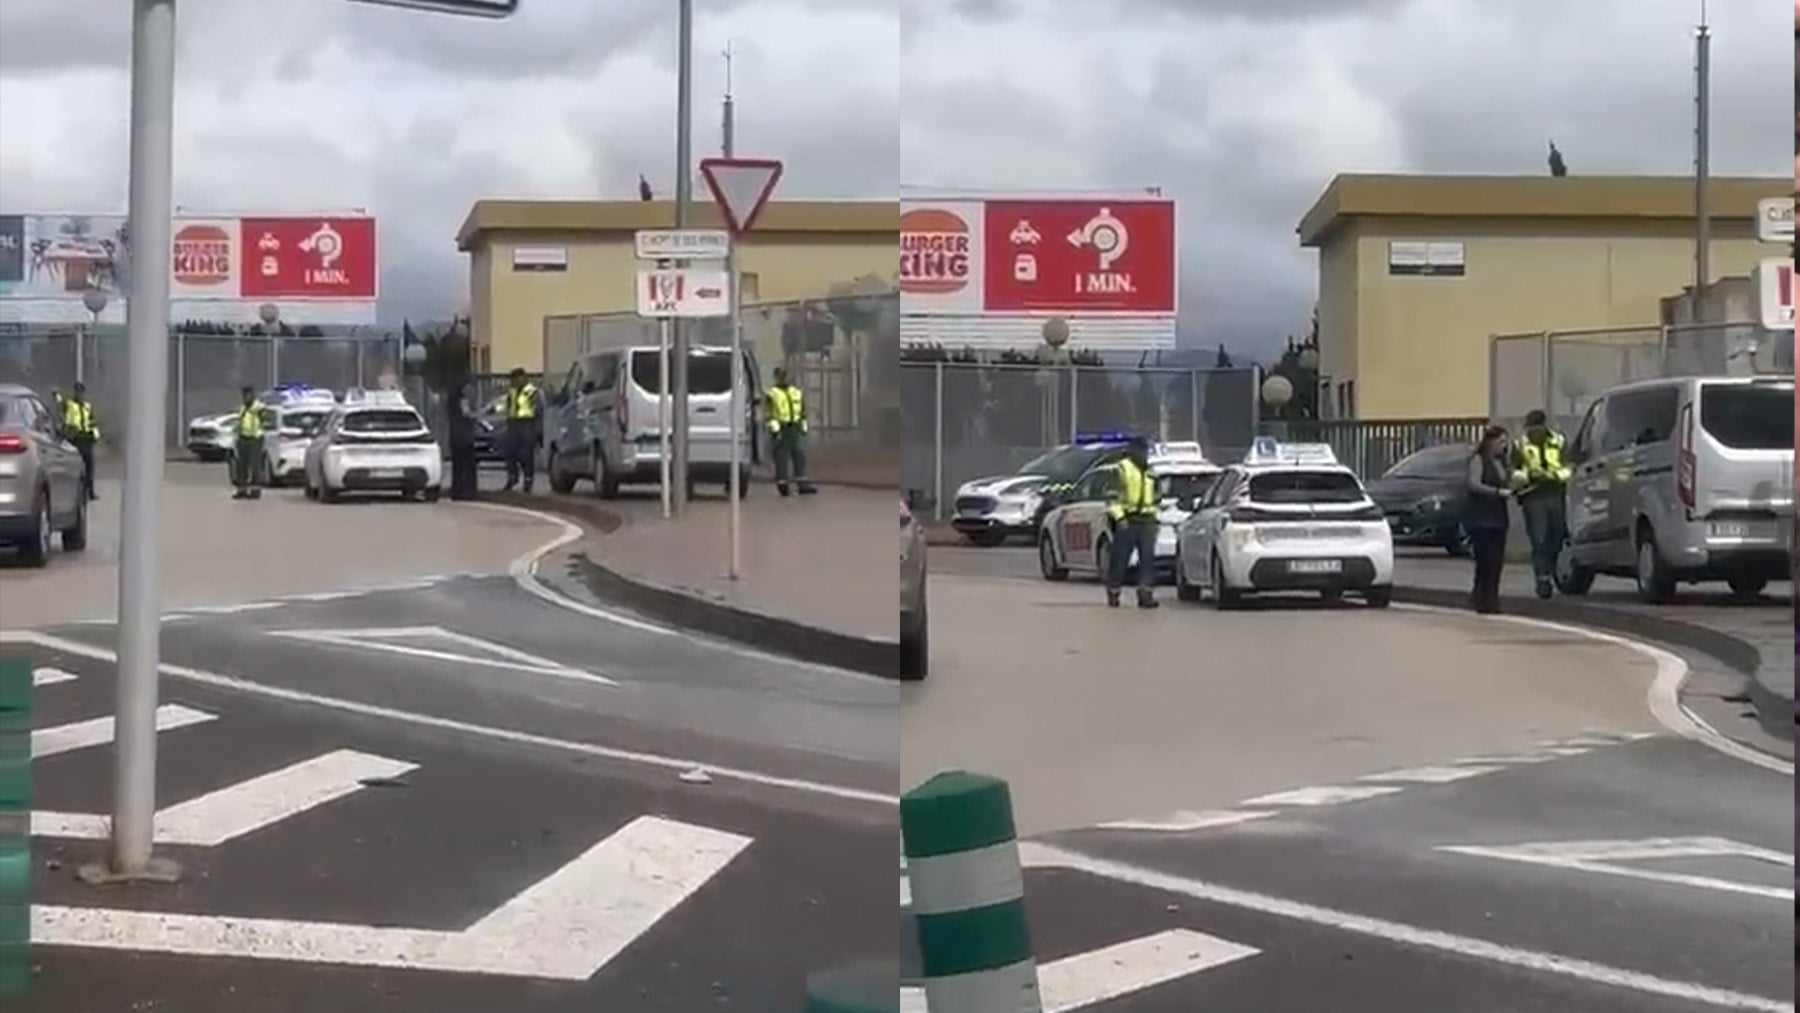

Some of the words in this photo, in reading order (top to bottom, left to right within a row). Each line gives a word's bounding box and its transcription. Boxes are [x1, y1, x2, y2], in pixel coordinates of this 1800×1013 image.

[900, 235, 969, 253] URGER
[174, 256, 229, 273] KING
[313, 269, 350, 284] MIN.
[1086, 273, 1137, 292] MIN.
